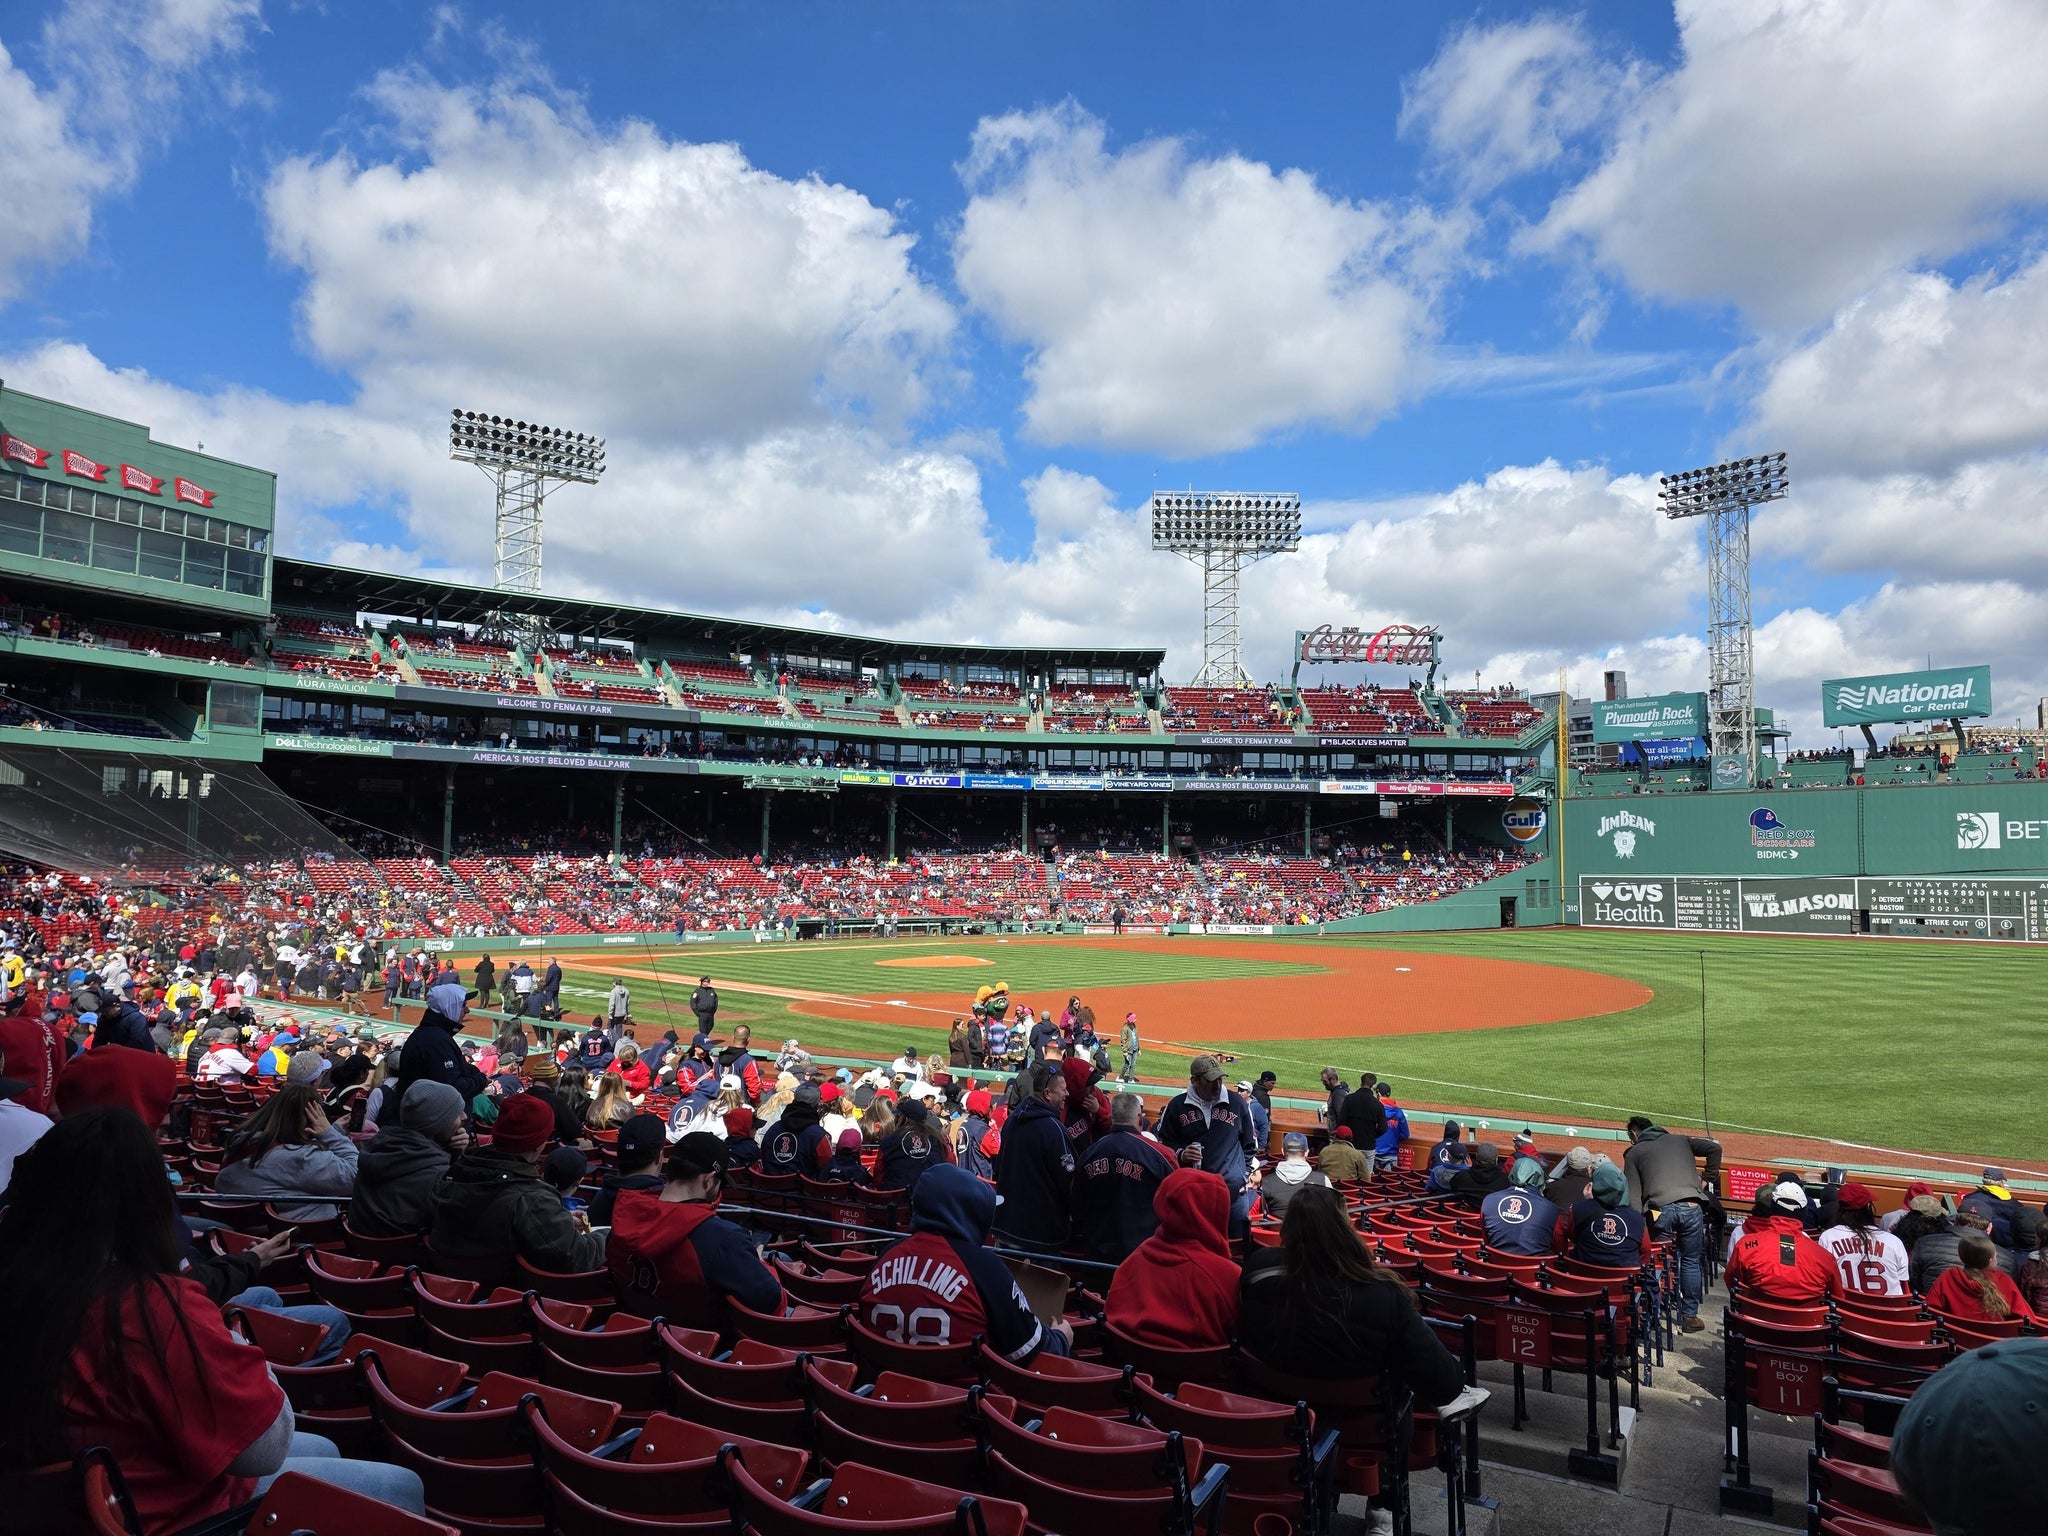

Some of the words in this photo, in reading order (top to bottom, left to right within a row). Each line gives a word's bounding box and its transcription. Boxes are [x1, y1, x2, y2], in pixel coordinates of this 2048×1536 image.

[1301, 624, 1440, 664] Coca-Cola
[296, 678, 325, 689] AURA
[328, 682, 368, 693] PAVILION
[1866, 678, 1974, 706] National
[497, 698, 537, 709] WELCOME
[541, 701, 550, 710] TO
[554, 702, 588, 713] FENWAY
[590, 705, 612, 715] PARK
[1902, 704, 1924, 714] Car
[1927, 700, 1969, 711] Rental
[1605, 707, 1660, 726] Plymouth
[1662, 705, 1693, 720] Rock
[786, 721, 814, 729] PAVILION
[1652, 718, 1694, 728] assurance
[276, 738, 303, 748] DELL
[302, 739, 357, 752] Technologies
[358, 743, 380, 753] Level
[1245, 737, 1272, 745] FENWAY
[1333, 738, 1357, 746] BLACK
[1657, 746, 1688, 754] all-star
[473, 753, 519, 763] AMERICA'S
[523, 755, 545, 764] MOST
[548, 757, 585, 767] BELOVED
[588, 759, 630, 769] BALLPARK
[919, 777, 947, 785] HYCU
[1242, 782, 1272, 790] BELOVED
[1389, 785, 1407, 793] Ninety
[1503, 813, 1542, 827] Gulf
[1597, 815, 1621, 837] JIM
[1619, 810, 1656, 837] BEAM
[1757, 830, 1783, 839] RED
[1787, 830, 1815, 839] SOX
[2006, 821, 2048, 839] BET
[1757, 840, 1815, 848] SCHOLARS
[1757, 850, 1788, 859] BIDMC
[1614, 883, 1663, 902] CVS
[1566, 905, 1578, 913] 310
[1595, 903, 1664, 923] Health
[519, 938, 546, 947] Franklin
[603, 936, 636, 944] smartwater
[588, 1043, 601, 1056] 11
[43, 1048, 53, 1097] CULTURAL
[1179, 1108, 1203, 1127] RED
[1212, 1107, 1238, 1127] SOX
[198, 1128, 207, 1138] 17
[1067, 1118, 1089, 1139] RED
[780, 1136, 790, 1152] B
[1084, 1157, 1109, 1180] RED
[1115, 1157, 1145, 1181] SOX
[1731, 1169, 1769, 1180] CAUTION!
[1507, 1198, 1522, 1214] B
[840, 1209, 860, 1218] FIELD
[1502, 1211, 1525, 1220] STRONG
[842, 1217, 857, 1225] BOX
[1602, 1217, 1617, 1235] B
[843, 1229, 857, 1243] 14
[1597, 1232, 1621, 1241] STRONG
[1744, 1239, 1759, 1250] HH
[1831, 1237, 1885, 1258] DURAN
[870, 1255, 969, 1303] SCHILLING
[1841, 1260, 1888, 1296] 16
[871, 1303, 950, 1346] 38
[1507, 1313, 1539, 1326] FIELD
[1511, 1324, 1535, 1336] BOX
[1512, 1337, 1536, 1357] 12
[1771, 1359, 1809, 1373] FIELD
[1776, 1371, 1804, 1384] BOX
[1780, 1386, 1801, 1406] 11
